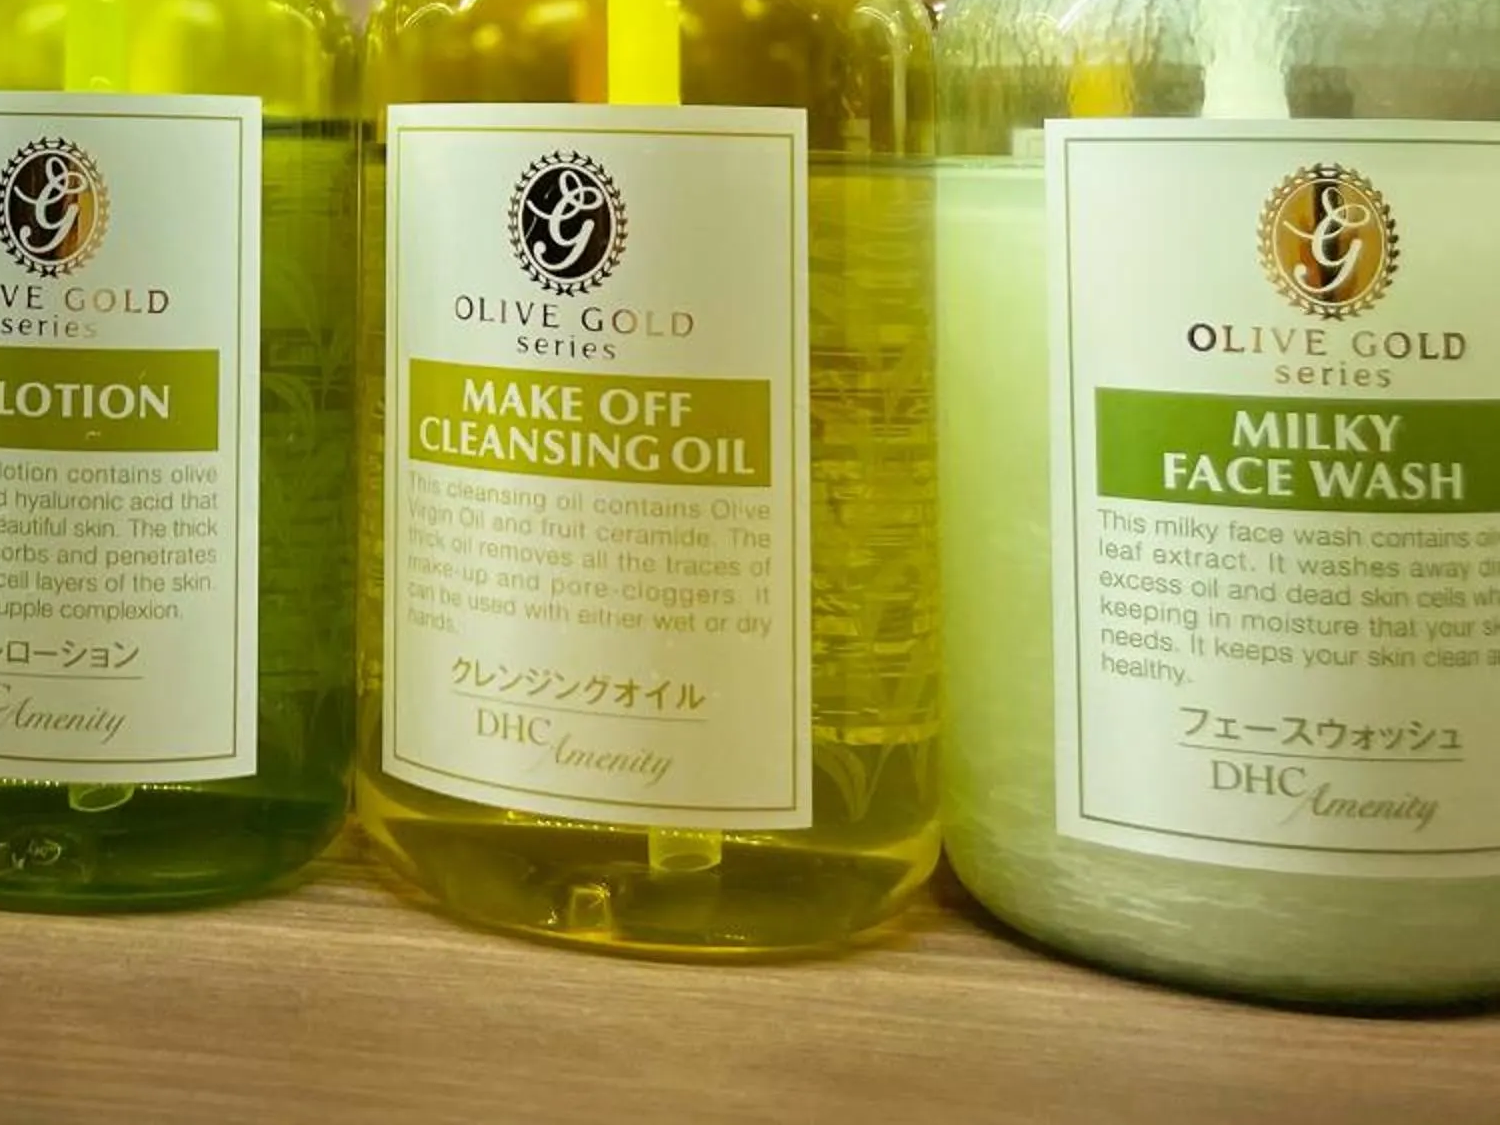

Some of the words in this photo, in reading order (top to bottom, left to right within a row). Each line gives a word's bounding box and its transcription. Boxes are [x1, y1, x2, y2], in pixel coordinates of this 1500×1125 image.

[65, 287, 169, 314] GOLD
[455, 296, 559, 328] OLIVE
[582, 307, 694, 336] GOLD
[2, 315, 96, 338] series
[1188, 323, 1327, 356] OLIVE
[1352, 332, 1466, 360] GOLD
[517, 334, 616, 360] series
[1275, 361, 1391, 387] series
[462, 379, 582, 421] MAKE
[600, 389, 691, 426] OFF
[420, 417, 659, 472] CLEANSING
[672, 437, 754, 474] OIL
[1232, 410, 1401, 452] MILKY
[0, 461, 57, 482] lotion
[68, 464, 162, 484] contains
[171, 465, 217, 484] olive
[1164, 453, 1292, 495] FACE
[1309, 460, 1464, 499] WASH
[15, 490, 122, 512] hyaluronic
[130, 492, 173, 511] acid
[181, 492, 218, 511] that
[410, 471, 440, 495] This
[447, 482, 546, 513] cleansing
[557, 492, 583, 513] oil
[593, 495, 699, 518] contains
[711, 499, 770, 520] Olive
[129, 519, 166, 538] The
[408, 499, 452, 526] Virgin
[459, 507, 484, 526] Oil
[493, 513, 531, 535] and
[541, 518, 586, 538] fruit
[729, 528, 770, 547] The
[1099, 509, 1145, 534] This
[1155, 516, 1219, 544] milky
[1229, 522, 1284, 543] face
[1293, 527, 1361, 547] wash
[1371, 528, 1470, 549] contains
[57, 546, 98, 565] and
[106, 547, 217, 568] penetrates
[452, 534, 471, 554] oil
[479, 542, 572, 567] removes
[583, 549, 607, 569] all
[618, 553, 656, 573] the
[666, 556, 740, 576] traces
[750, 557, 770, 577] of
[1153, 545, 1256, 573] extract.
[1297, 556, 1399, 576] washes
[1410, 559, 1470, 581] away
[36, 573, 97, 595] layers
[105, 575, 125, 592] of
[133, 575, 165, 592] the
[498, 571, 539, 592] and
[1099, 570, 1181, 595] excess
[1191, 577, 1219, 597] oil
[1229, 583, 1276, 601] and
[1286, 585, 1350, 607] dead
[1361, 586, 1408, 607] skin
[1417, 586, 1466, 608] cells
[439, 586, 462, 606] be
[525, 601, 568, 622] with
[654, 612, 695, 632] wet
[705, 615, 728, 633] or
[737, 611, 771, 637] dry
[1101, 596, 1197, 628] keeping
[1209, 607, 1230, 627] in
[1241, 612, 1358, 636] moisture
[1370, 616, 1415, 637] that
[1427, 619, 1473, 641] your
[1215, 637, 1293, 665] keeps
[1302, 645, 1357, 668] your
[1368, 644, 1415, 666] skin
[1424, 646, 1478, 667] clean
[452, 656, 706, 712] クレンジングオイル
[477, 708, 551, 746] DHC
[539, 734, 674, 788] Amenity
[1179, 707, 1464, 752] フェースウォッシュ
[1211, 759, 1307, 797] DHC
[1279, 782, 1440, 831] Amenity
